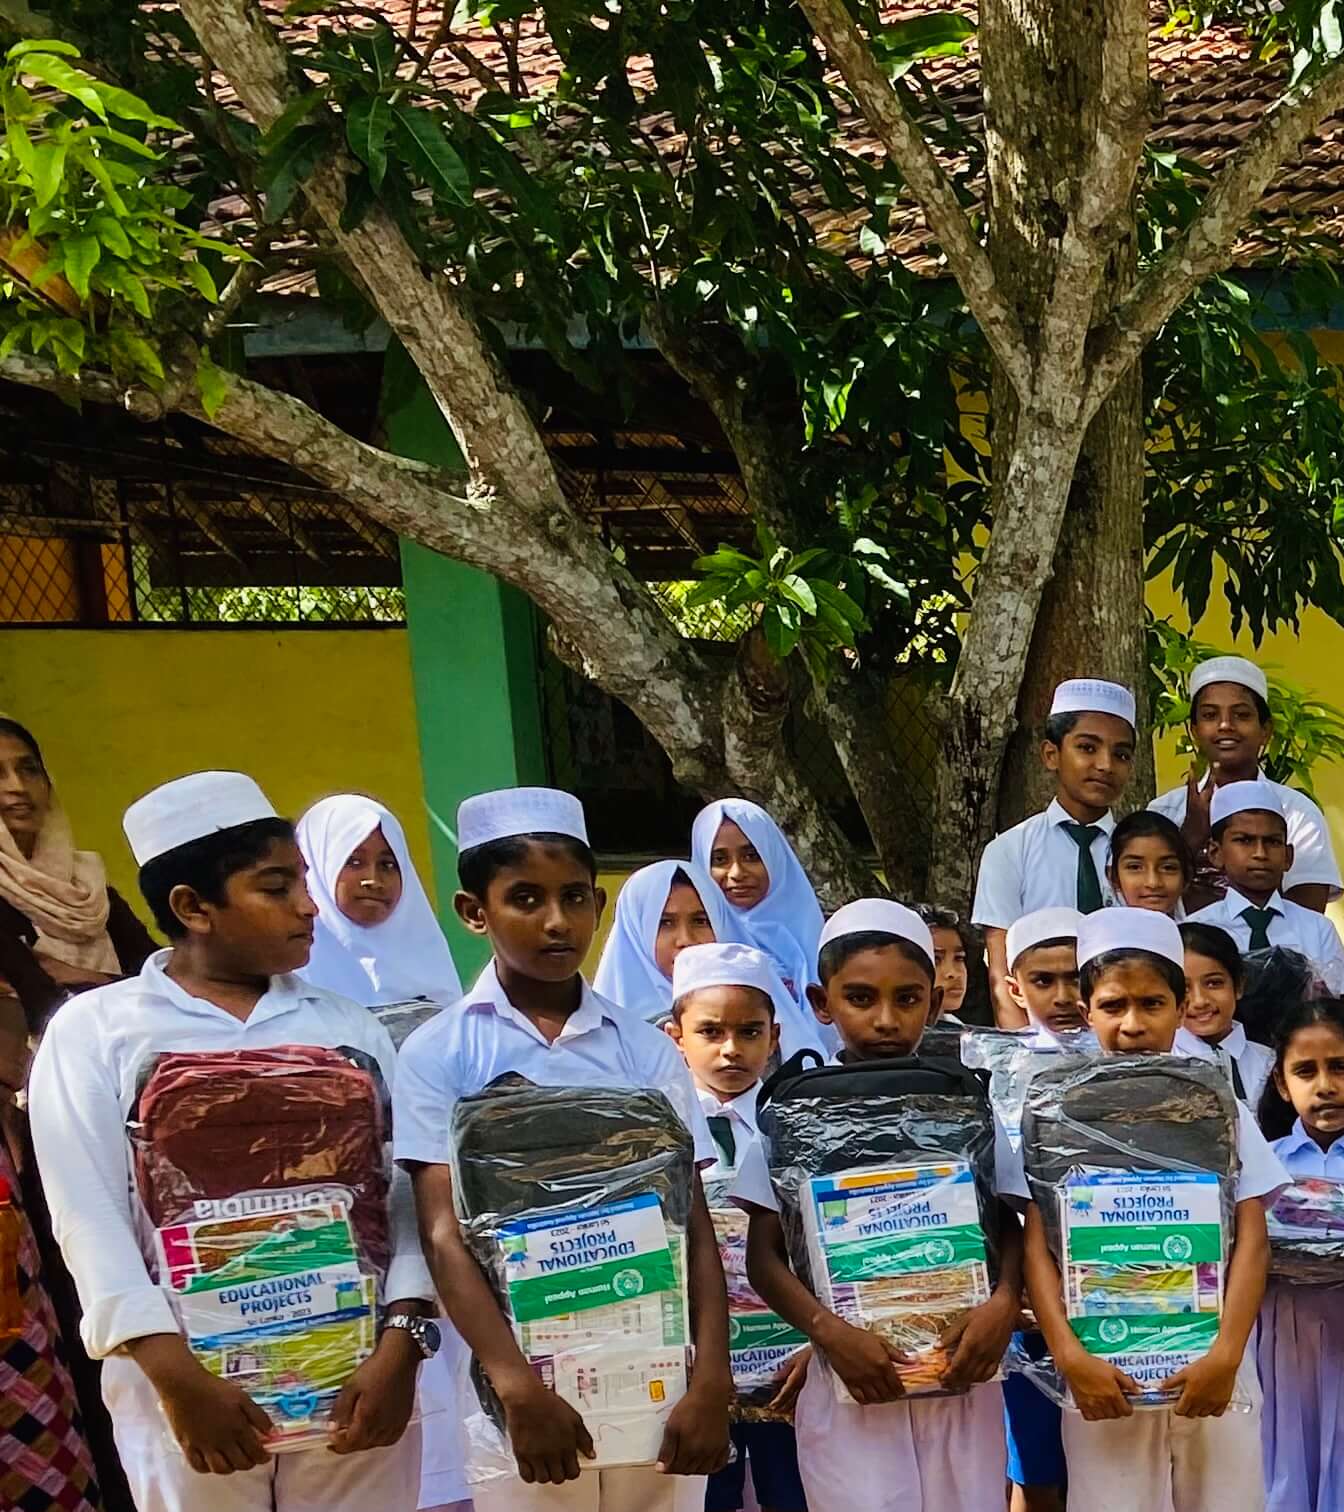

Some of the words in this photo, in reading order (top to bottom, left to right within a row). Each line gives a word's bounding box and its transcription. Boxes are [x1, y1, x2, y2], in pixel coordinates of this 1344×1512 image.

[1112, 1194, 1174, 1209] PROJECTS
[855, 1212, 948, 1236] EDUCATIONAL
[1099, 1209, 1190, 1223] EDUCATIONAL
[550, 1229, 616, 1254] PROJECTS
[536, 1240, 636, 1273] EDUCATIONAL
[218, 1272, 325, 1305] EDUCATIONAL
[239, 1291, 313, 1316] PROJECTS
